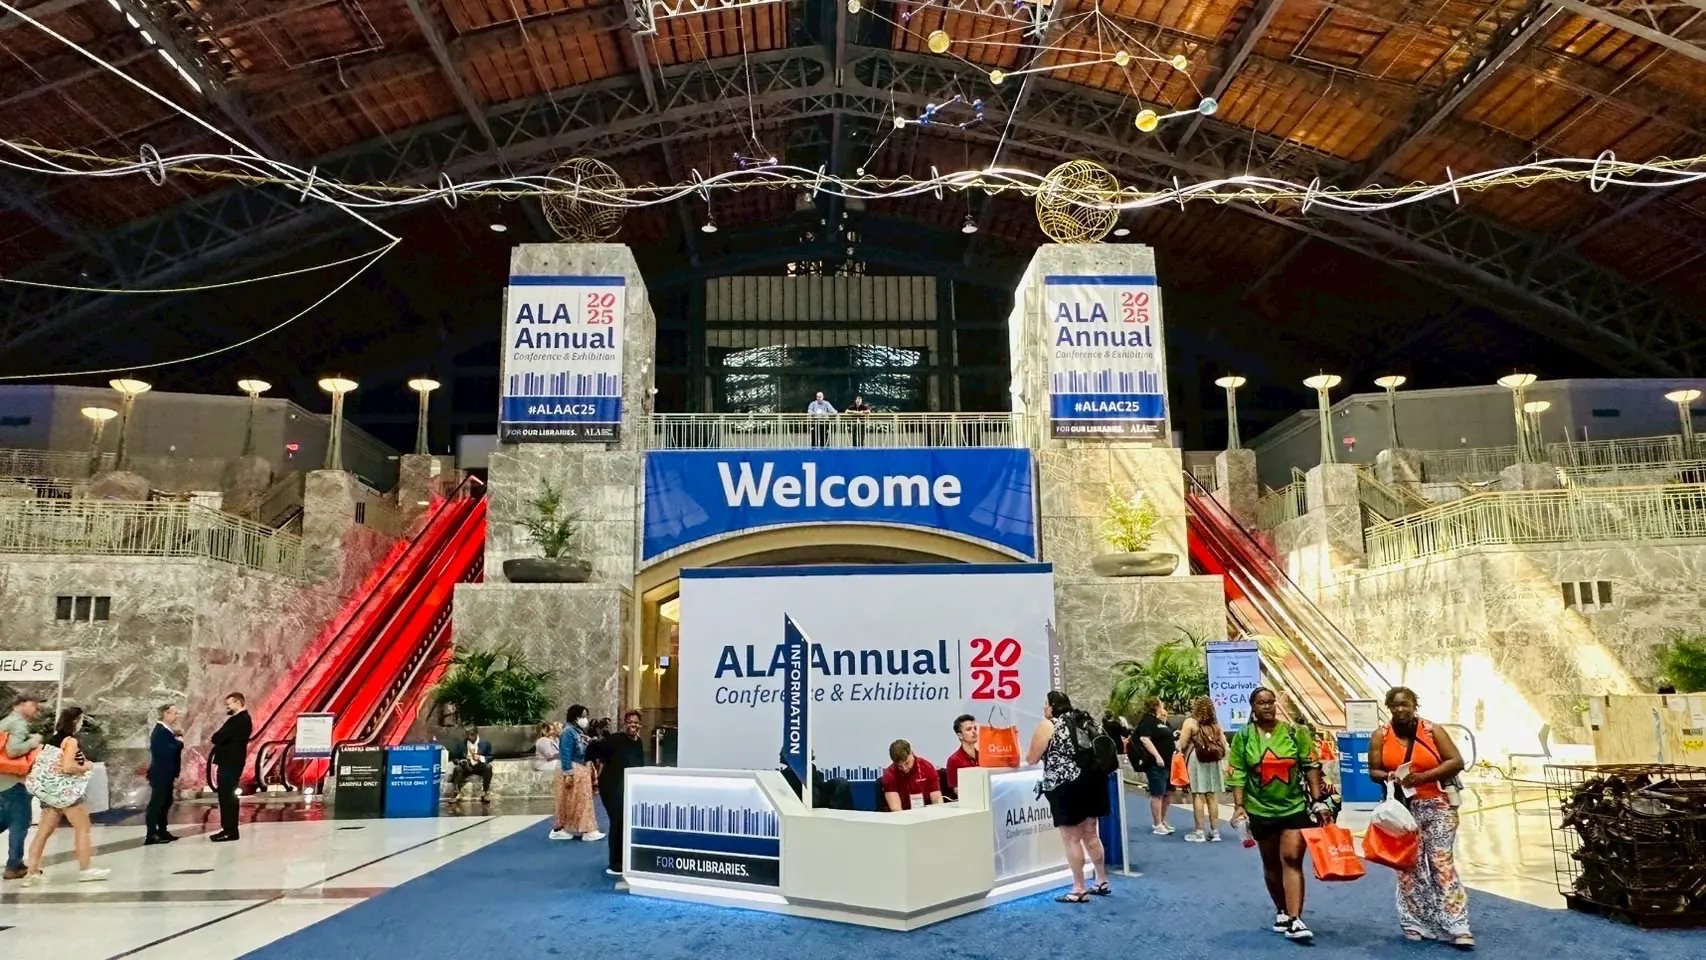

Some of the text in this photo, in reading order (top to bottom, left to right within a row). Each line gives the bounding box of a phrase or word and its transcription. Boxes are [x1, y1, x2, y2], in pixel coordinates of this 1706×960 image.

[587, 292, 616, 308] 20
[1121, 291, 1149, 307] 20
[515, 303, 572, 324] ALA
[586, 309, 614, 324] 25
[1054, 302, 1108, 323] ALA
[1122, 308, 1149, 323] 25
[514, 326, 615, 349] Annual
[1055, 325, 1152, 347] Annual
[513, 352, 615, 362] Conference & Exhibition
[1055, 350, 1153, 360] Conference & Exhibition
[528, 404, 596, 415] #ALAAC25
[1074, 401, 1140, 412] #ALAAC25
[506, 429, 521, 437] FOR
[584, 428, 600, 436] ALA
[717, 462, 962, 507] Welcome
[714, 640, 950, 678] ALA Annual
[970, 638, 1022, 667] 20
[1053, 654, 1061, 690] MOBI
[715, 681, 949, 707] Conferee & Exhibition
[971, 670, 1021, 699] 25
[790, 644, 800, 754] INFORMATION
[1006, 805, 1052, 827] ALA Annu
[656, 856, 749, 876] FOR OUR LIBRARIES.
